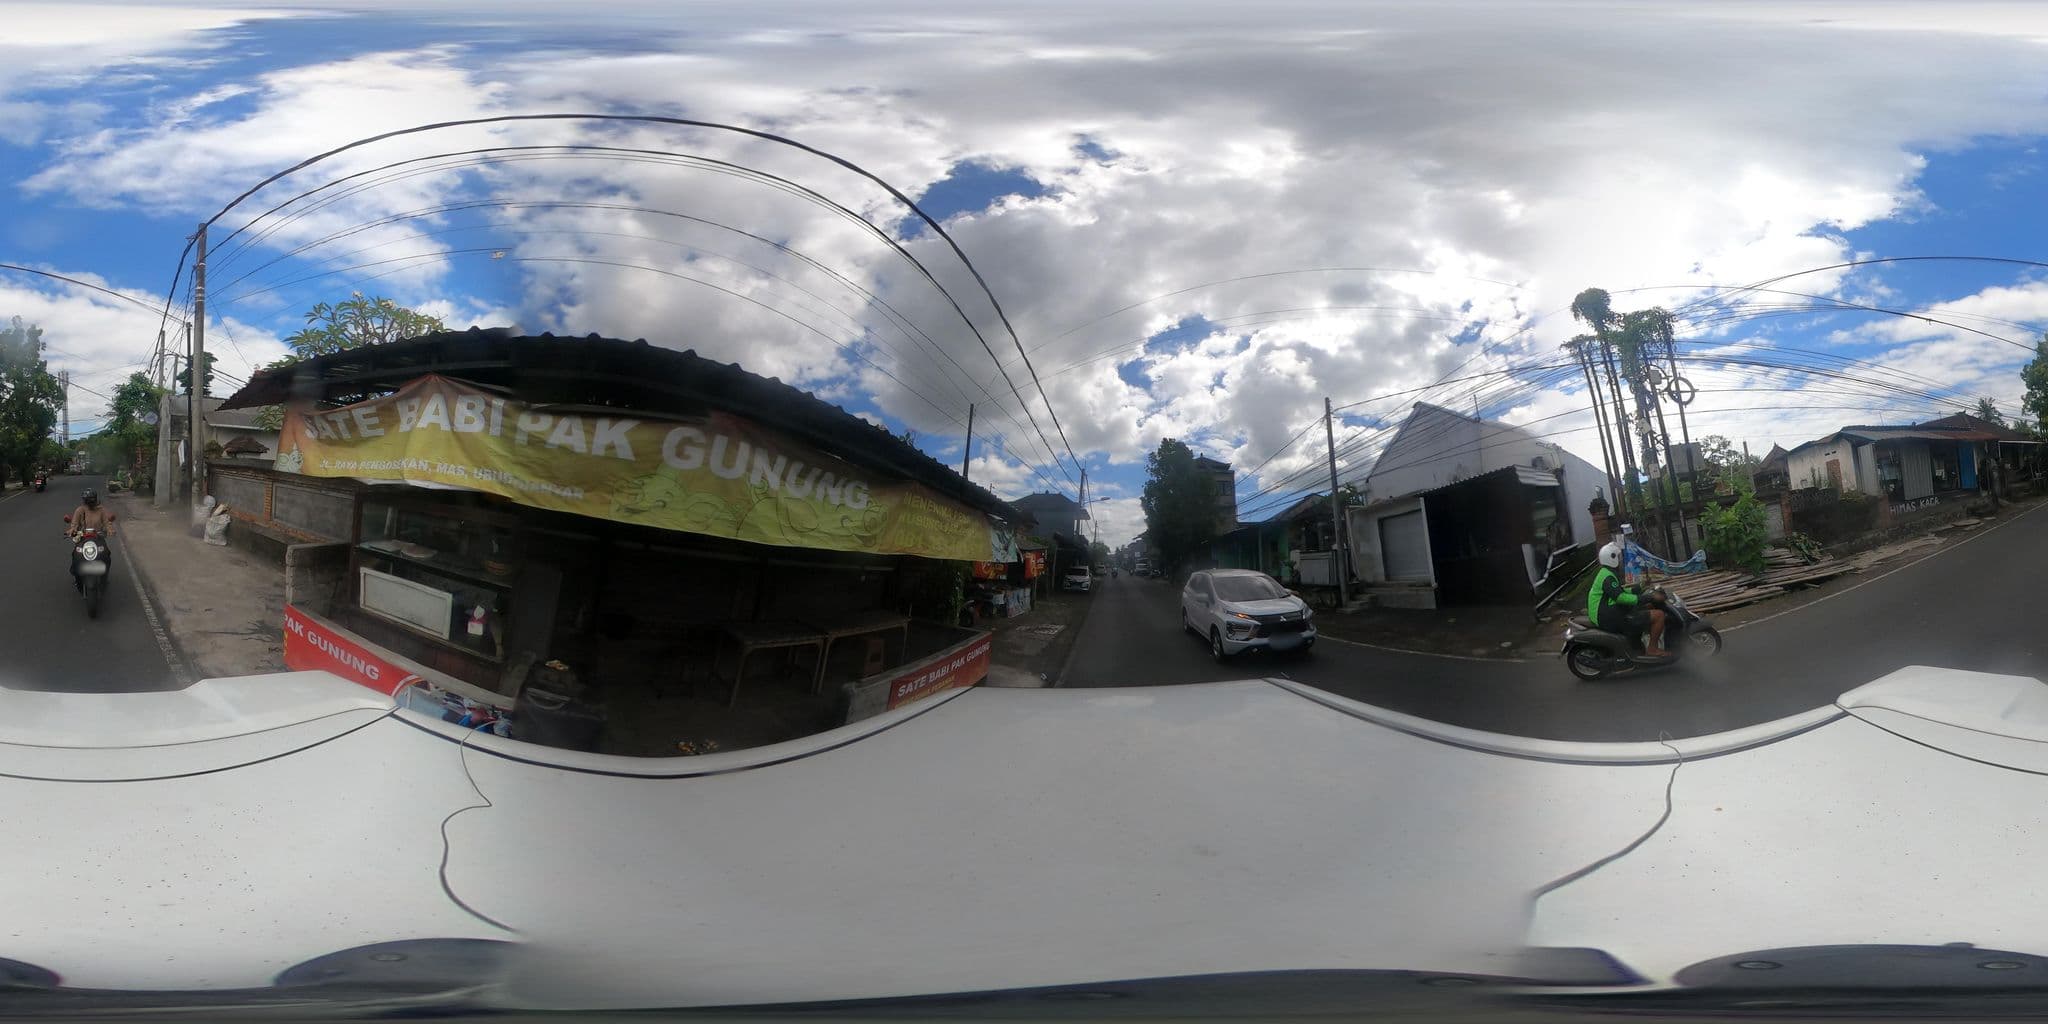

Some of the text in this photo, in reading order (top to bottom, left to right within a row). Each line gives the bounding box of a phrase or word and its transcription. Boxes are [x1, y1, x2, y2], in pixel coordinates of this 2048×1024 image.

[303, 392, 872, 509] SATE BABI PAK GUNUNG
[307, 631, 380, 681] GUNUNG
[897, 675, 927, 697] SATE
[928, 662, 951, 684] BABI
[950, 656, 966, 672] PAK
[966, 641, 991, 662] GUNUNG
